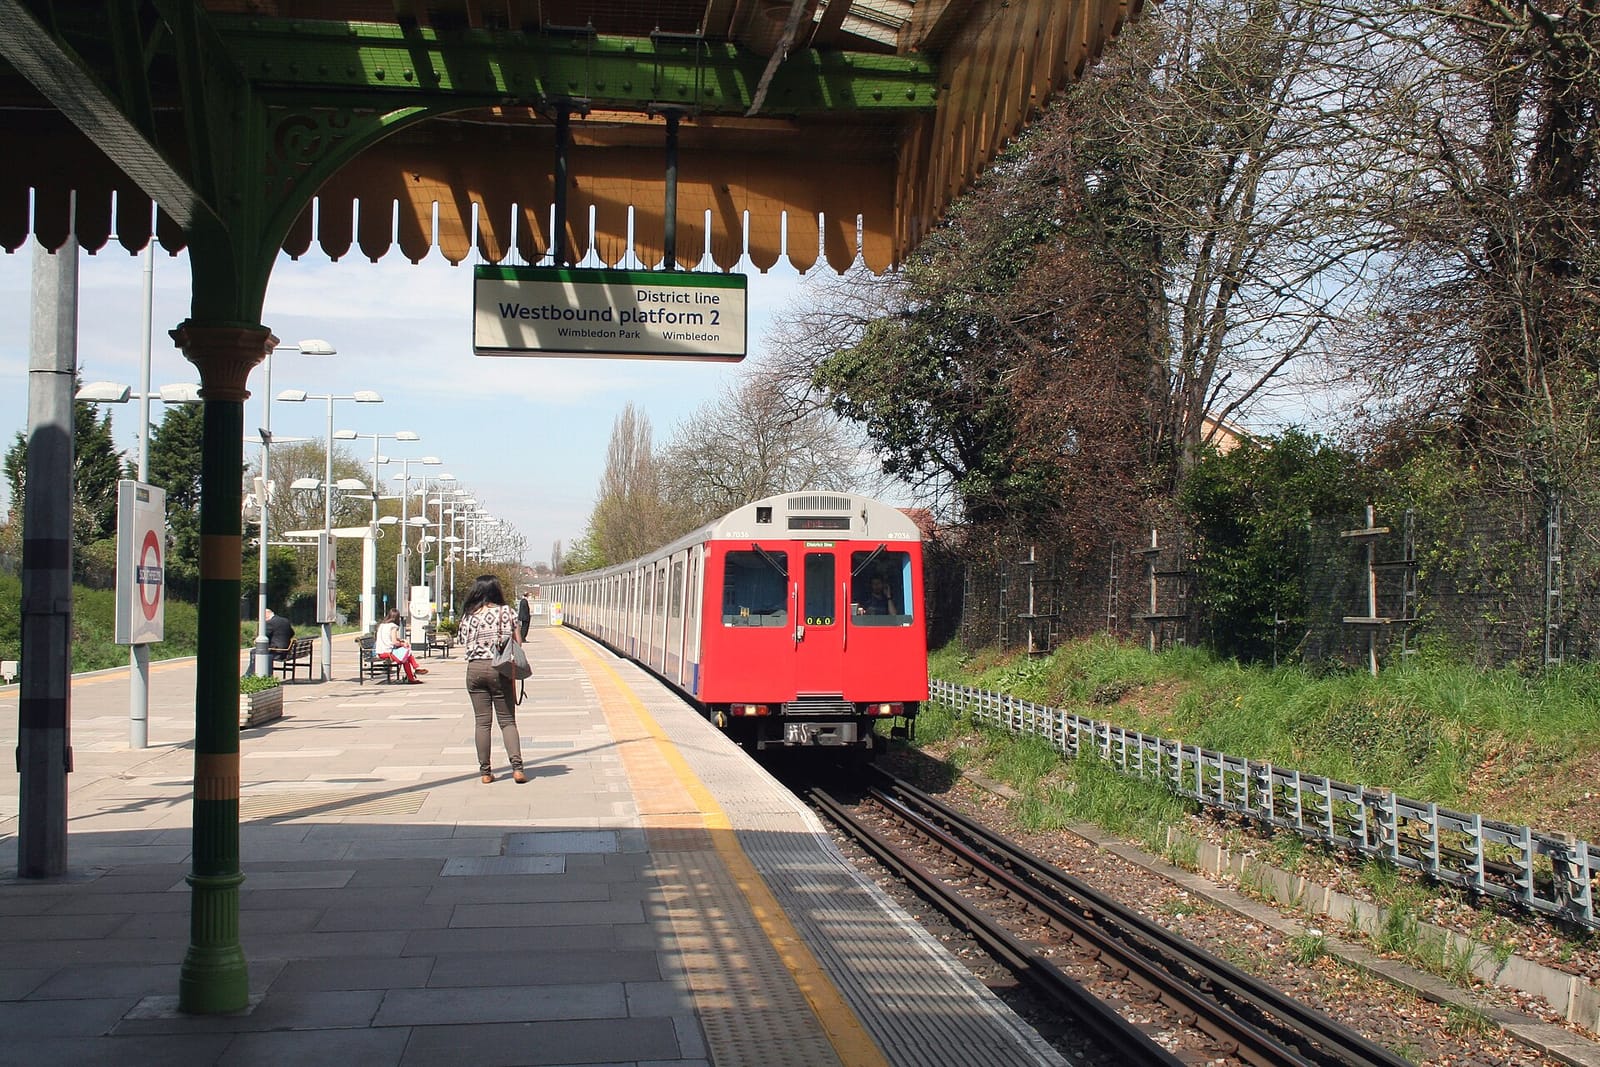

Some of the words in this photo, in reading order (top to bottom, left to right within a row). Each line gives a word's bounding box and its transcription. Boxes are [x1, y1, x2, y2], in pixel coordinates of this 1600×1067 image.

[637, 290, 690, 303] District
[695, 292, 720, 305] line
[499, 303, 613, 322] Westbound
[620, 307, 703, 329] platform
[709, 310, 720, 326] 2
[558, 327, 616, 339] Wimbledon
[619, 329, 641, 340] Park
[662, 331, 720, 342] Wimbledon
